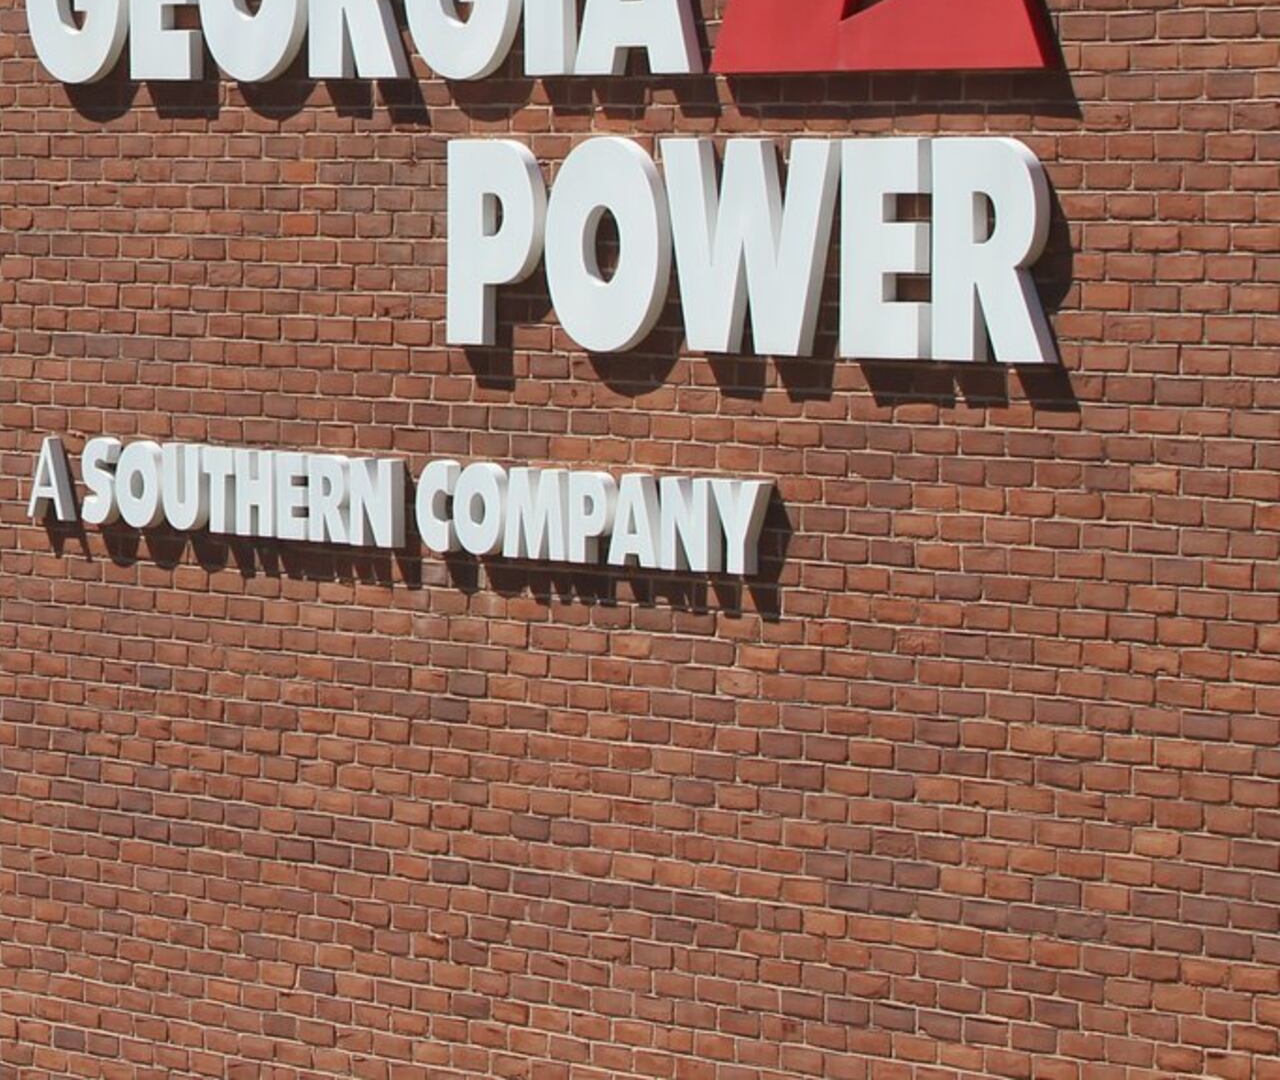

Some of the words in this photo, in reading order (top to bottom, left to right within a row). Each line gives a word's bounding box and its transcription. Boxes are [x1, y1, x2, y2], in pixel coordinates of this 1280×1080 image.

[445, 135, 1057, 364] POWER
[27, 437, 74, 521] A
[80, 436, 406, 549] SOUTHERN
[415, 459, 774, 576] COMPANY
